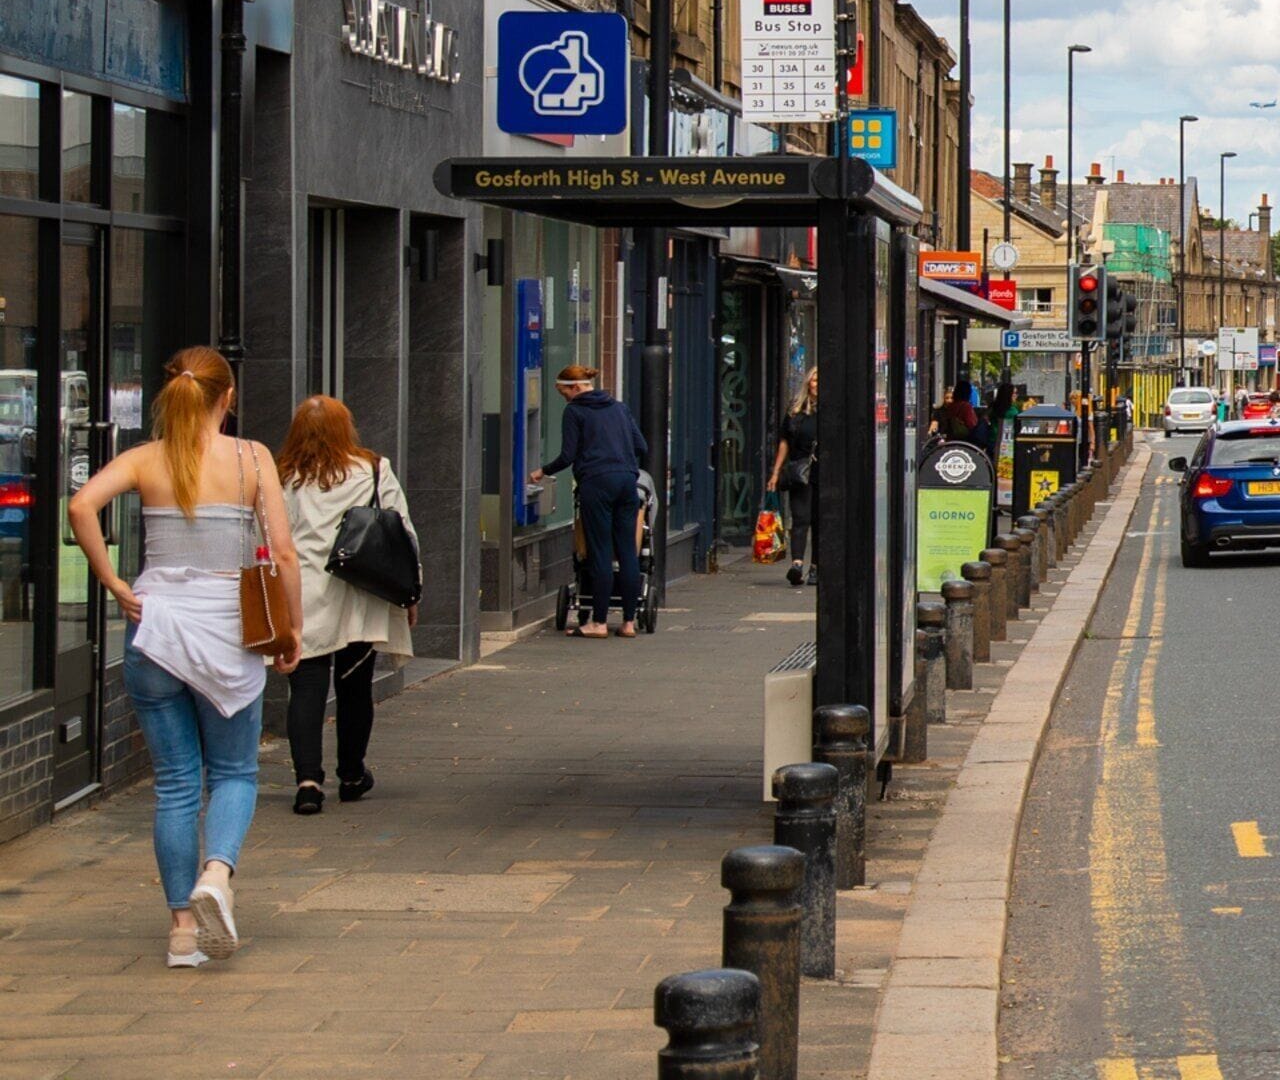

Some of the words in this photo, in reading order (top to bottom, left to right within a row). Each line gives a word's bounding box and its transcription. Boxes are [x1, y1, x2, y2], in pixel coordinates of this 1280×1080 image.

[770, 4, 806, 13] BUSES
[755, 20, 781, 31] Bus
[788, 20, 821, 34] Stop
[771, 43, 818, 51] nexus.org.uk
[752, 82, 763, 90] 31
[783, 82, 795, 90] 35
[814, 82, 826, 90] 45
[752, 100, 764, 108] 33
[783, 100, 795, 108] 43
[814, 100, 826, 108] 54
[476, 170, 561, 187] Gosforth
[568, 170, 614, 190] High
[621, 170, 639, 185] St
[660, 170, 705, 185] West
[712, 170, 786, 185] Avenue
[989, 289, 1014, 299] gfords
[1008, 334, 1017, 346] P
[1022, 332, 1055, 340] Gosforth
[929, 510, 976, 521] GIORNO
